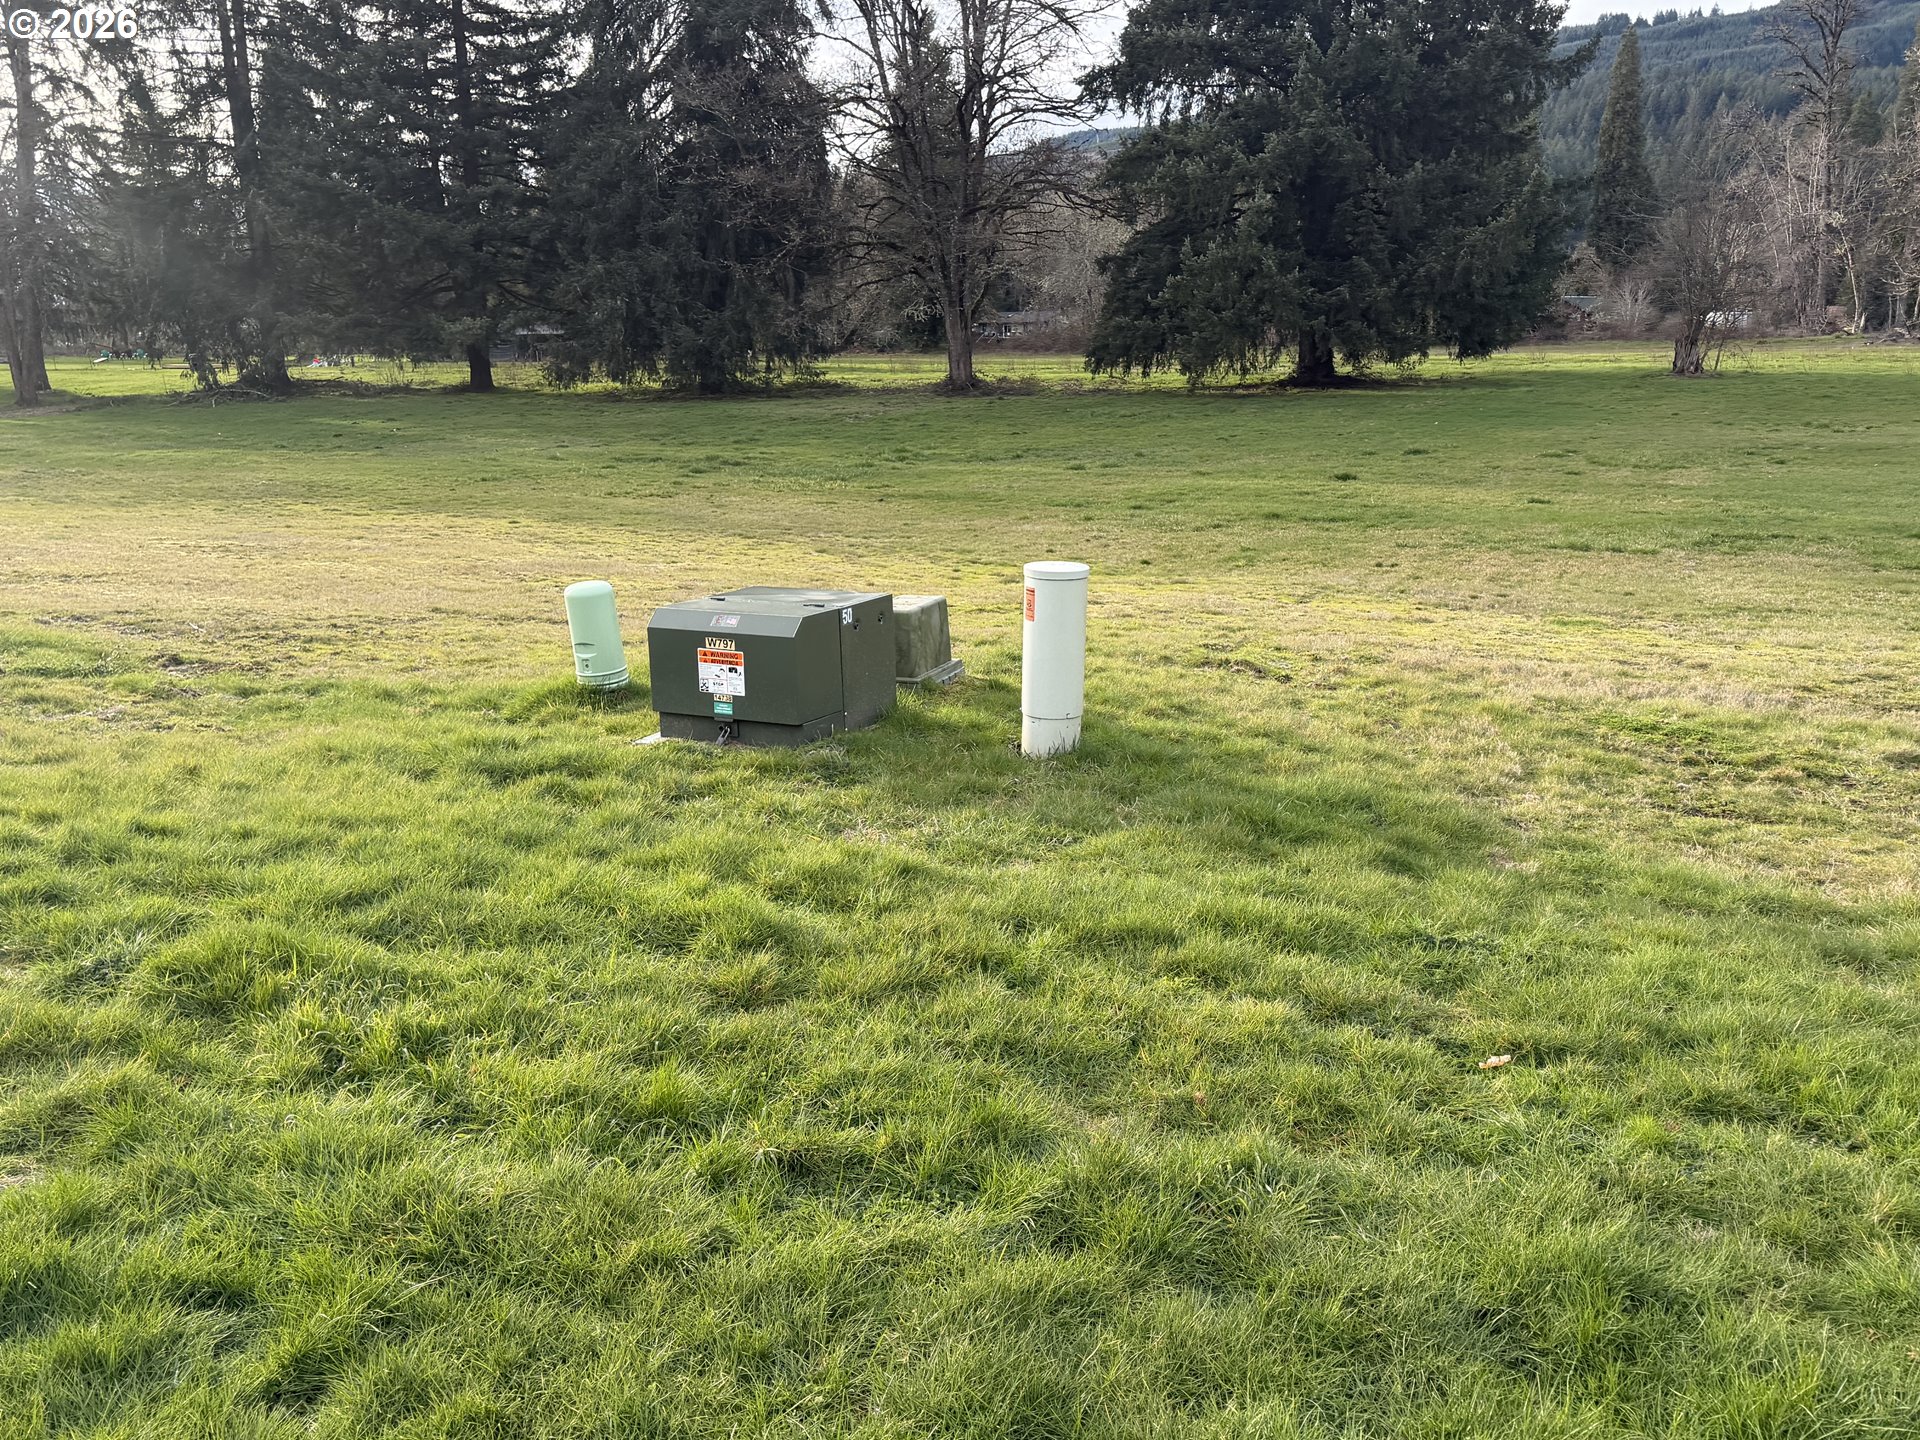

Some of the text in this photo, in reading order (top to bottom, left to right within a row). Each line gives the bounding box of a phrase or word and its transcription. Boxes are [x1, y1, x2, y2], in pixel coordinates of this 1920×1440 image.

[842, 607, 853, 625] 50
[707, 637, 734, 649] W797
[710, 651, 739, 660] WARNING
